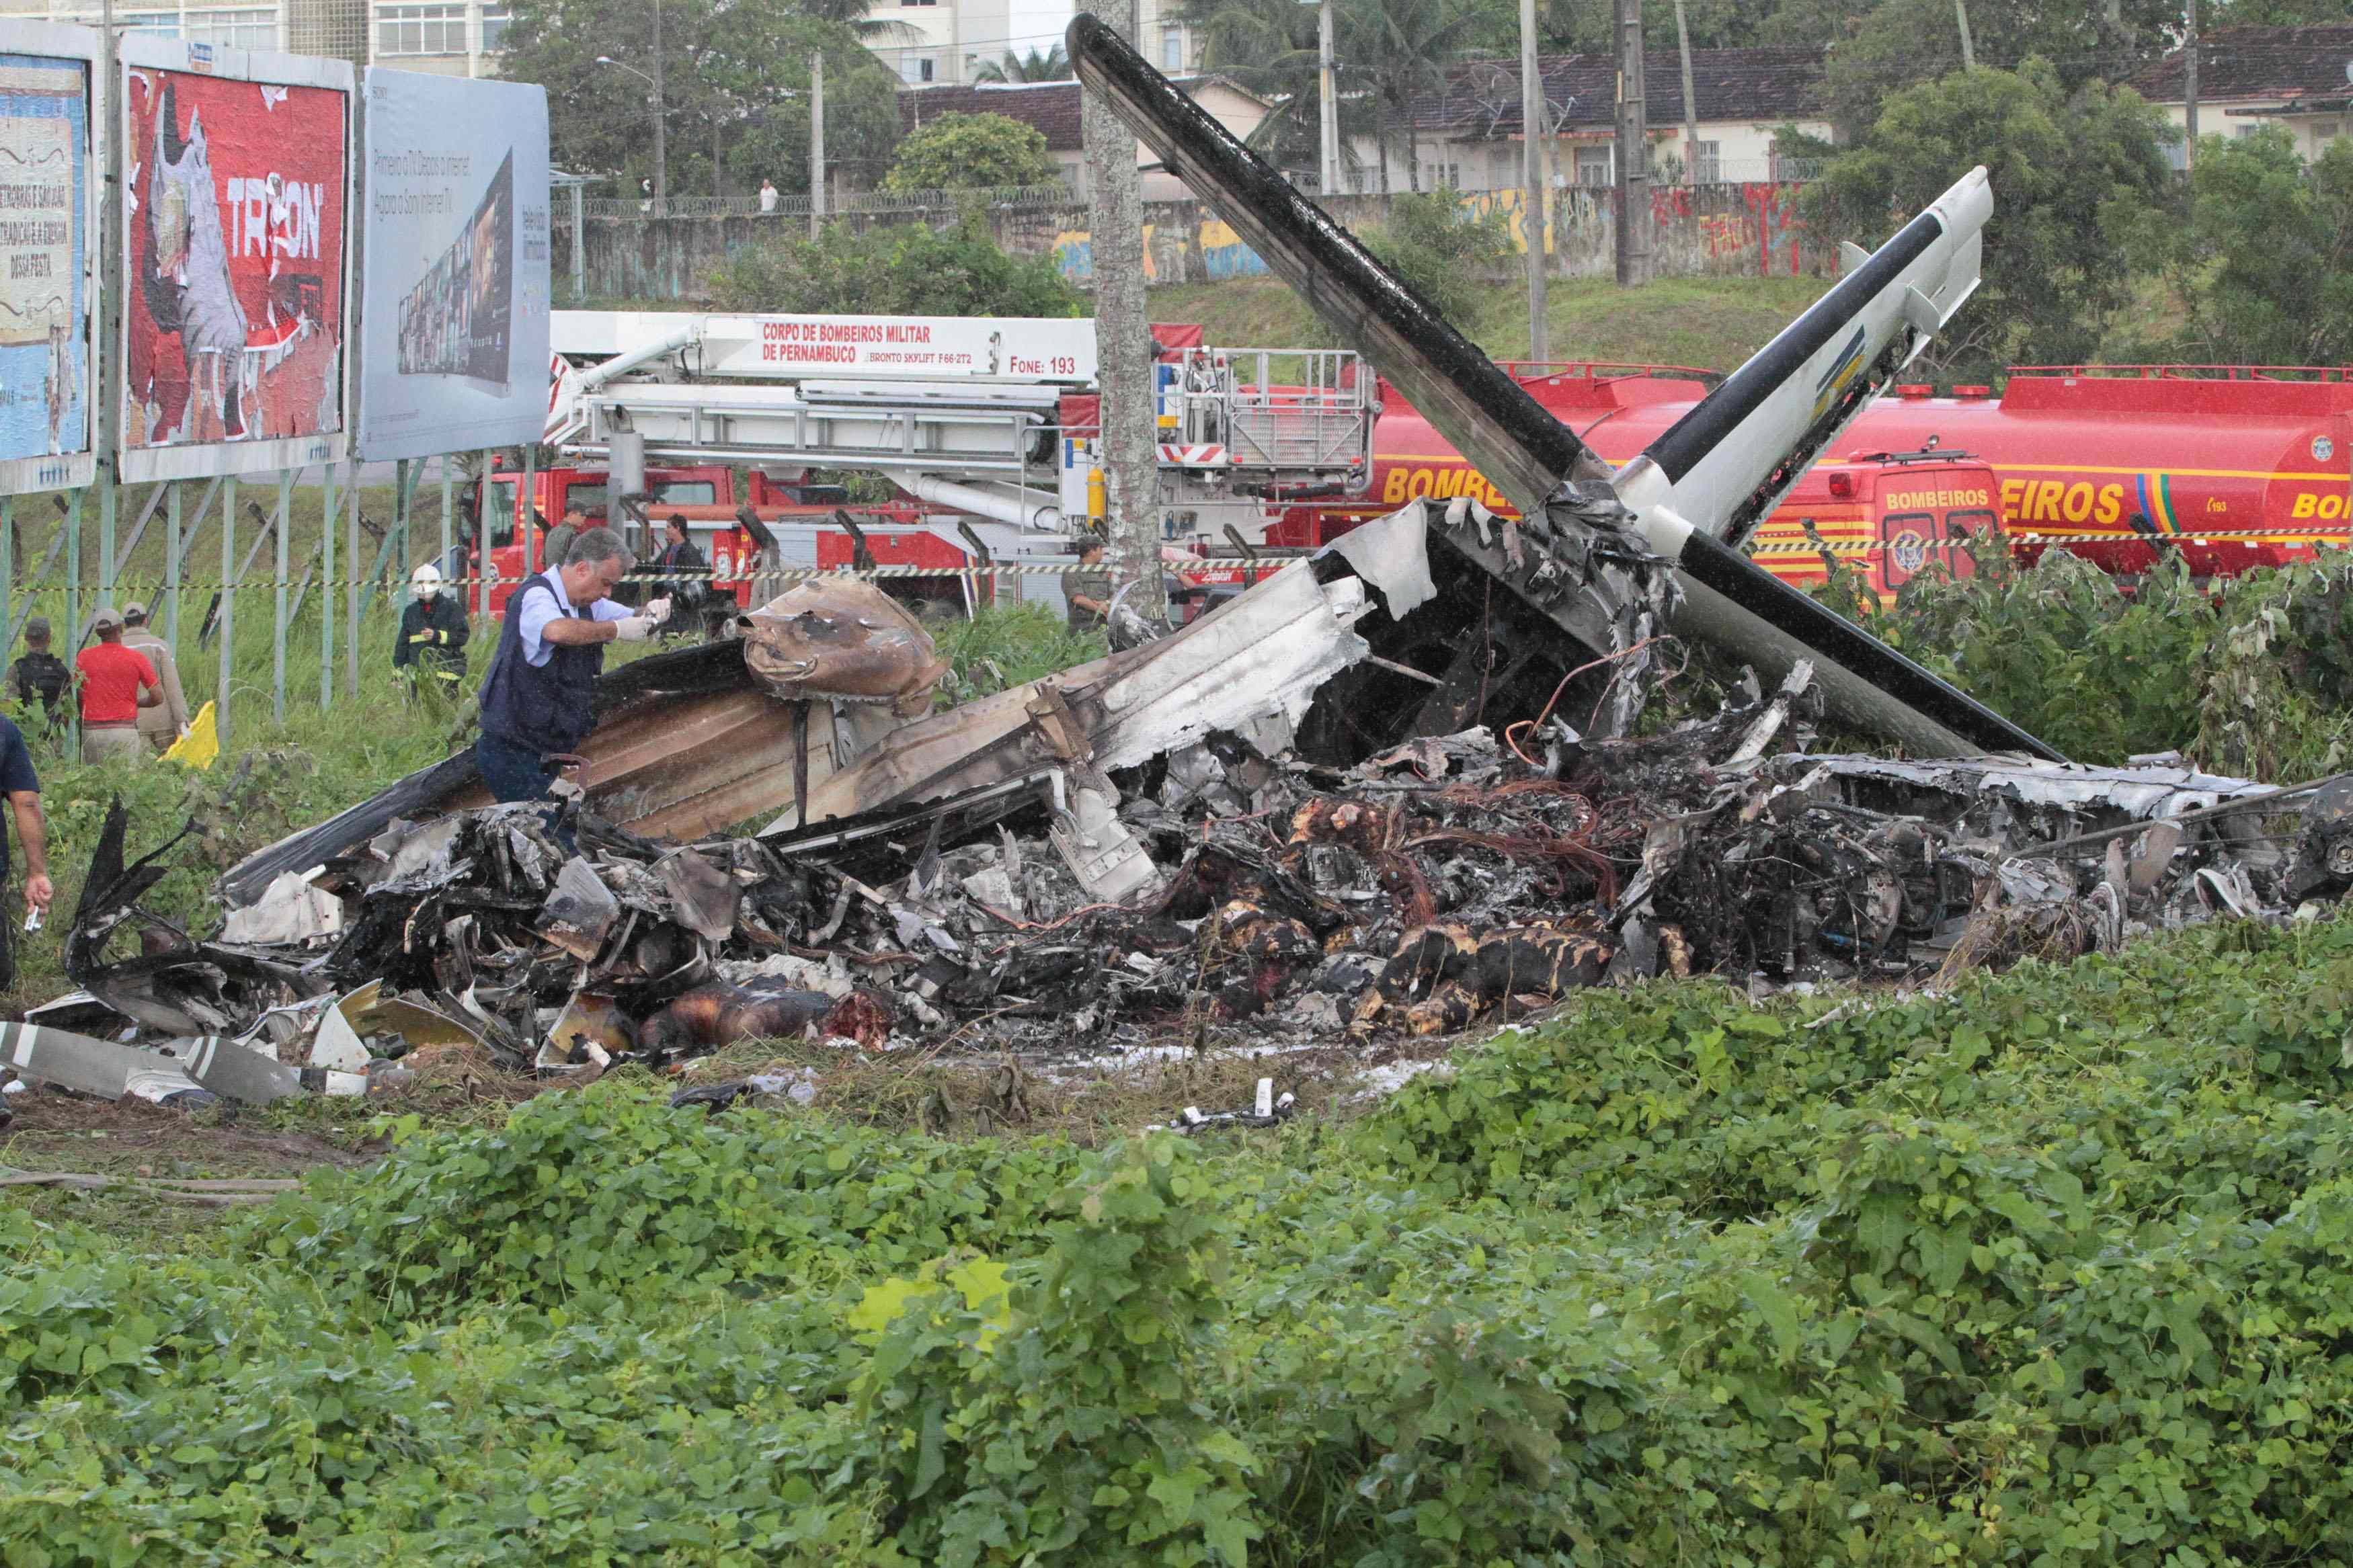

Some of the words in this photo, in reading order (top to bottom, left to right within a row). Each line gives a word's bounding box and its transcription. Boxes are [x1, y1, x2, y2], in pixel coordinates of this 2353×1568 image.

[763, 323, 799, 341] CORPO
[803, 324, 816, 341] DE
[820, 325, 883, 343] BOMBEIROS
[886, 325, 930, 343] MILITAR
[763, 343, 776, 361] DE
[780, 344, 856, 363] PERNAMBUCO
[869, 353, 902, 363] BRONTO
[904, 354, 934, 364] SKYLIFT
[1050, 357, 1075, 374] 193
[1383, 467, 1513, 507] BOMBE
[1886, 489, 1989, 510] BOMBEIROS
[2212, 501, 2227, 512] 193
